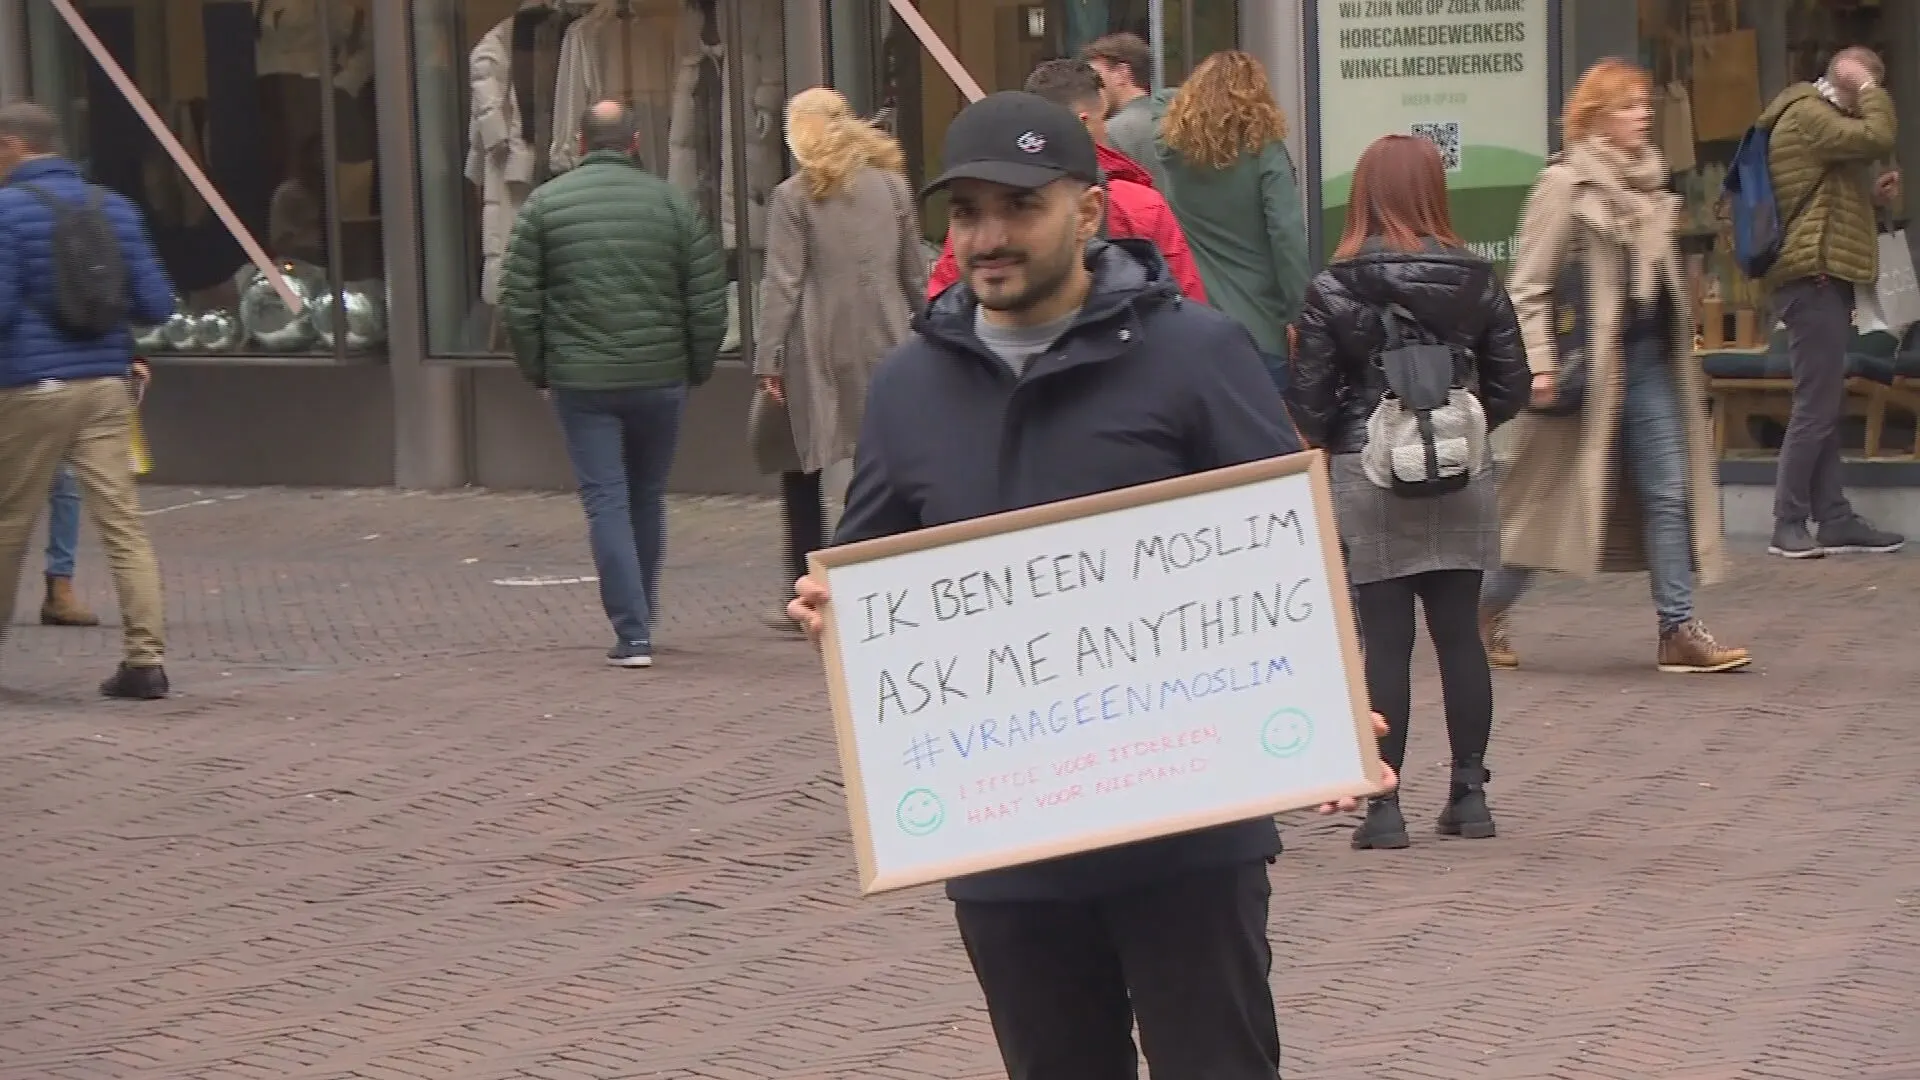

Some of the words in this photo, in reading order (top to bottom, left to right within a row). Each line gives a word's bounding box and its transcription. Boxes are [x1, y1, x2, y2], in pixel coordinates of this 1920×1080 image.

[1339, 0, 1361, 18] WIJ
[1364, 0, 1392, 17] ZIJN
[1396, 0, 1422, 16] NOG
[1426, 0, 1443, 15] OP
[1448, 0, 1480, 14] ZOEK
[1339, 21, 1526, 49] HORECAMEDEWERKERS
[1340, 52, 1525, 79] WINKELMEDEWERKERS
[857, 589, 920, 643] IK
[931, 565, 1014, 622] BEN
[1026, 549, 1107, 598] EEN
[1133, 508, 1305, 580] MOSLIM
[876, 655, 969, 723] ASK
[985, 632, 1060, 695] ME
[1076, 577, 1314, 677] ANYTHING
[902, 656, 1294, 770] #VRAAGEENMOSLIM
[1050, 752, 1099, 777] VOOR
[966, 798, 1023, 824] HAAT
[1036, 784, 1084, 809] VOOR
[1095, 756, 1209, 795] NIEMAND
